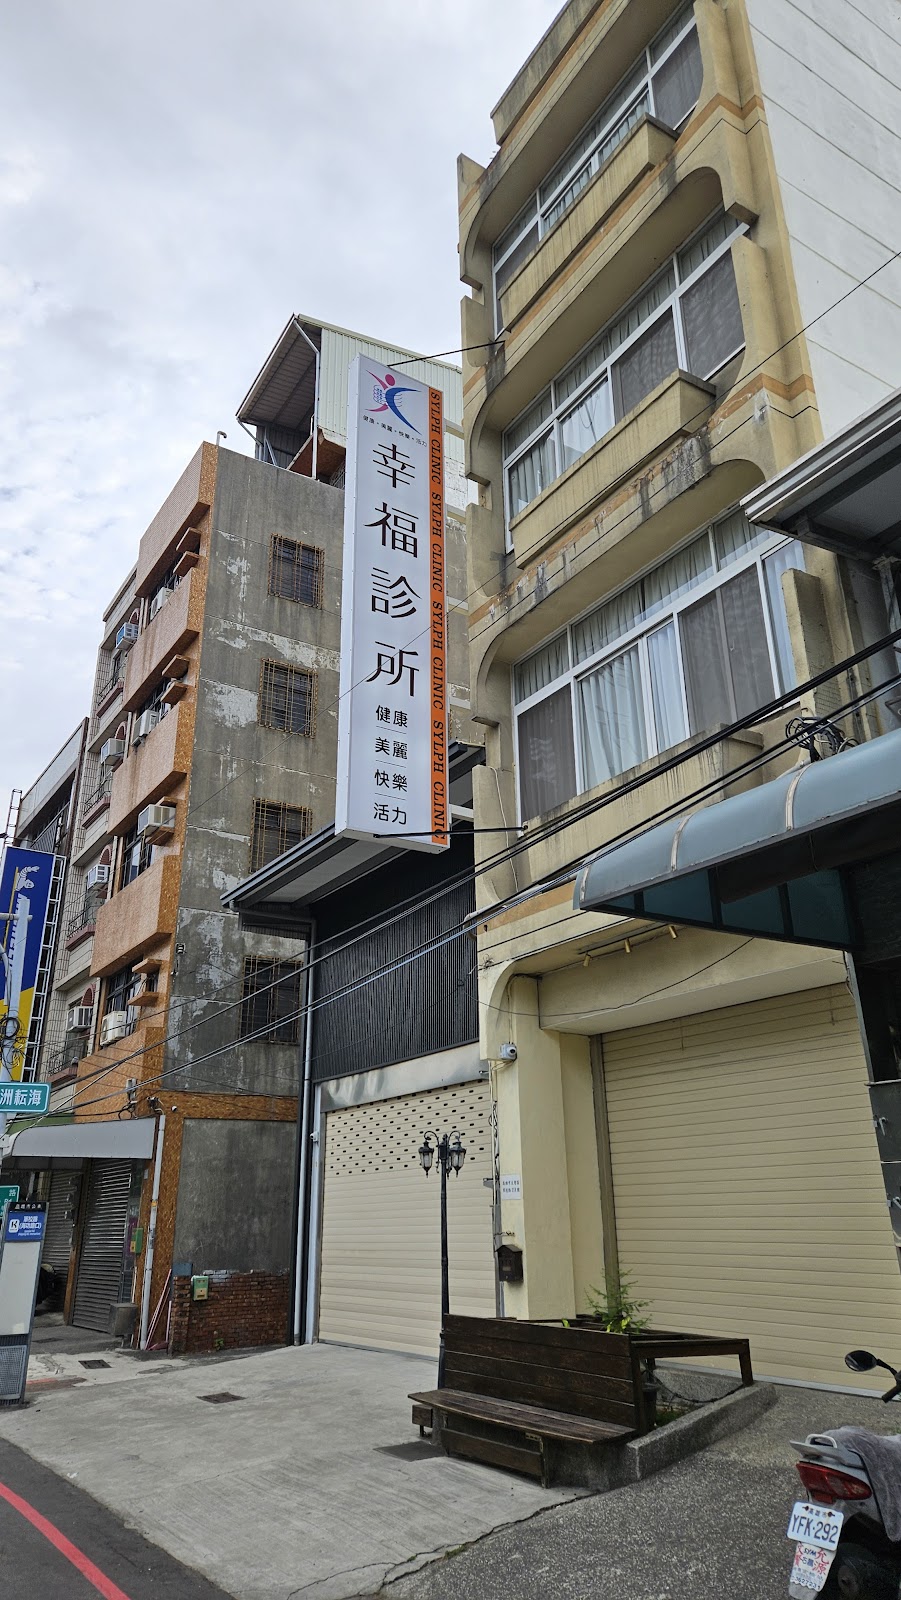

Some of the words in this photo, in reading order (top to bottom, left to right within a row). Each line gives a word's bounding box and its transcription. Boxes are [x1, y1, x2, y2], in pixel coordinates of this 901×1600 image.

[431, 391, 441, 435] SYLPH
[431, 440, 441, 485] CLINIC
[431, 492, 442, 538] SYLPH
[364, 443, 422, 697] 幸福診所
[432, 543, 442, 593] CLINIC
[432, 601, 443, 649] SYLPH
[432, 657, 444, 710] CLINIC
[375, 704, 408, 728] 健康
[375, 736, 408, 760] 美麗
[433, 720, 444, 773] SYLPH
[374, 768, 408, 792] 快樂
[373, 802, 407, 825] 活力
[433, 781, 445, 839] CLINIC
